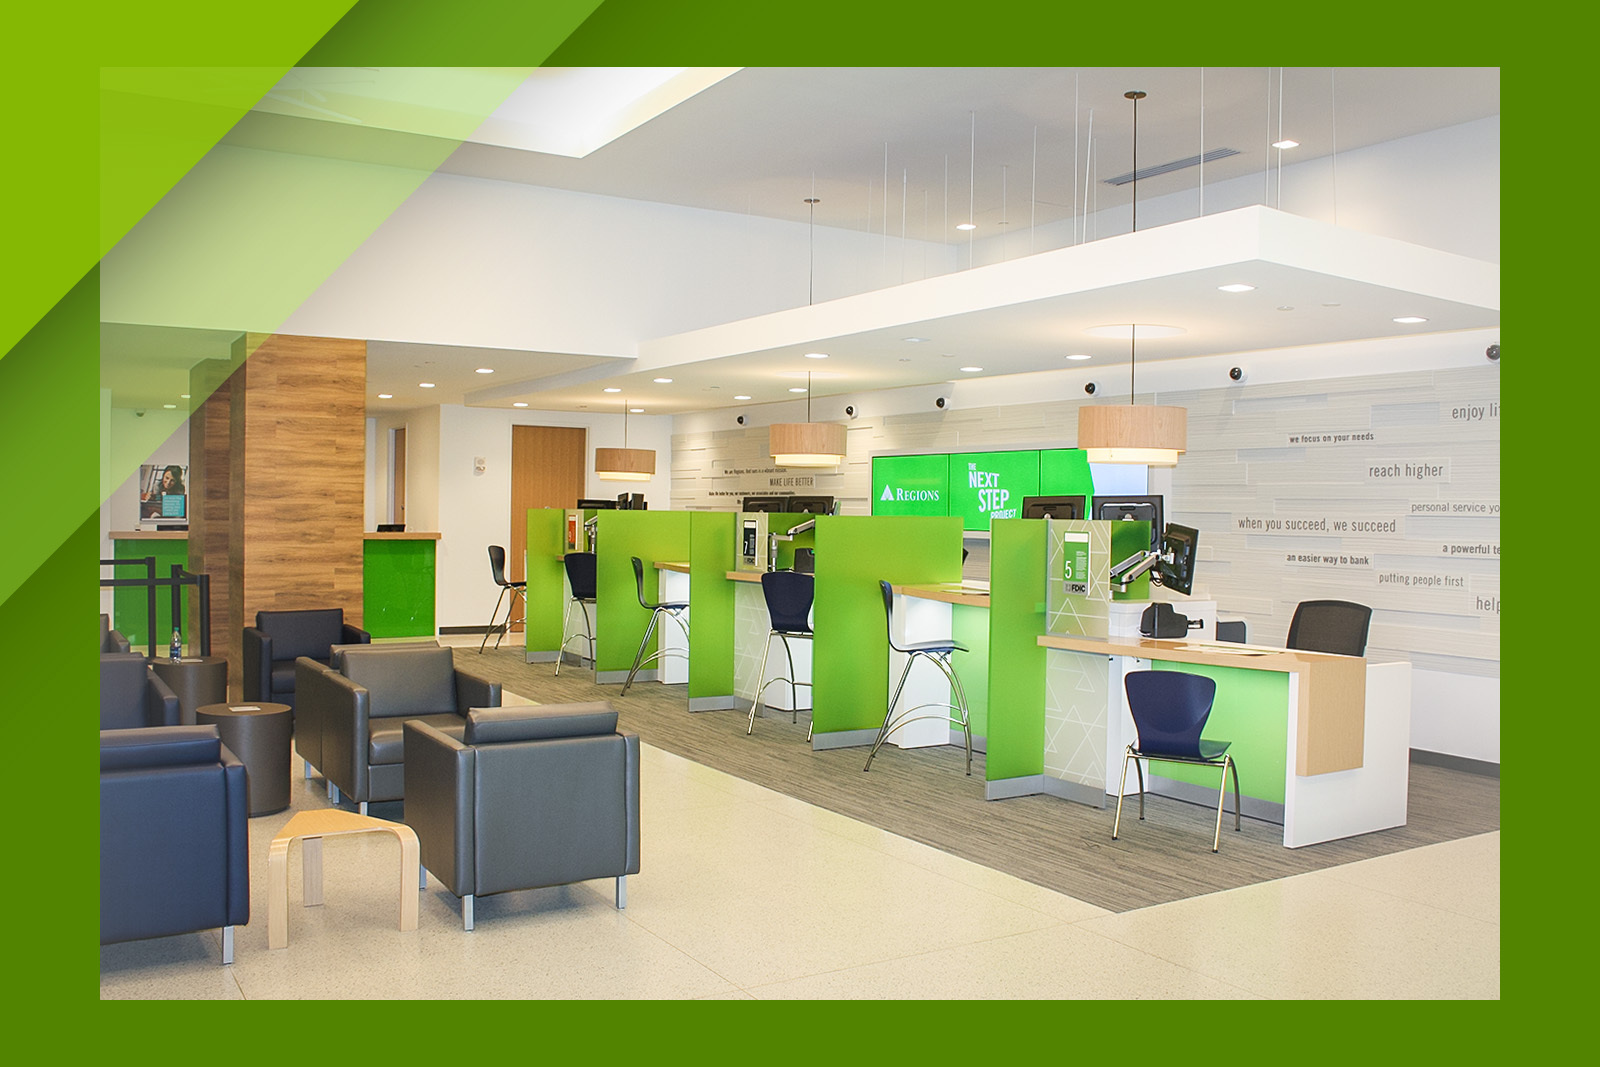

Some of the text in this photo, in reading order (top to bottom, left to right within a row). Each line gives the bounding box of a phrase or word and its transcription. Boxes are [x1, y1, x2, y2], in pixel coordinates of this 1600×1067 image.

[1452, 402, 1500, 421] enjoy li
[1301, 434, 1320, 443] focus
[1323, 434, 1331, 442] on
[1333, 434, 1350, 444] your
[1352, 432, 1374, 442] needs
[1369, 463, 1443, 479] reach higher
[795, 476, 814, 486] BETTER
[968, 471, 1000, 488] NEXT
[978, 489, 1010, 512] STEP
[1411, 503, 1449, 514] personal
[1452, 502, 1485, 512] service
[1238, 517, 1396, 533] when you succeed, we succeed
[744, 541, 748, 555] 7
[1442, 545, 1448, 553] a
[1450, 544, 1490, 554] powerful
[1298, 554, 1320, 563] easier
[1323, 557, 1338, 565] way
[1340, 556, 1348, 564] to
[1350, 556, 1369, 565] bank
[1065, 561, 1072, 579] 5
[1379, 573, 1464, 587] putting people first
[1072, 584, 1086, 592] FDIC
